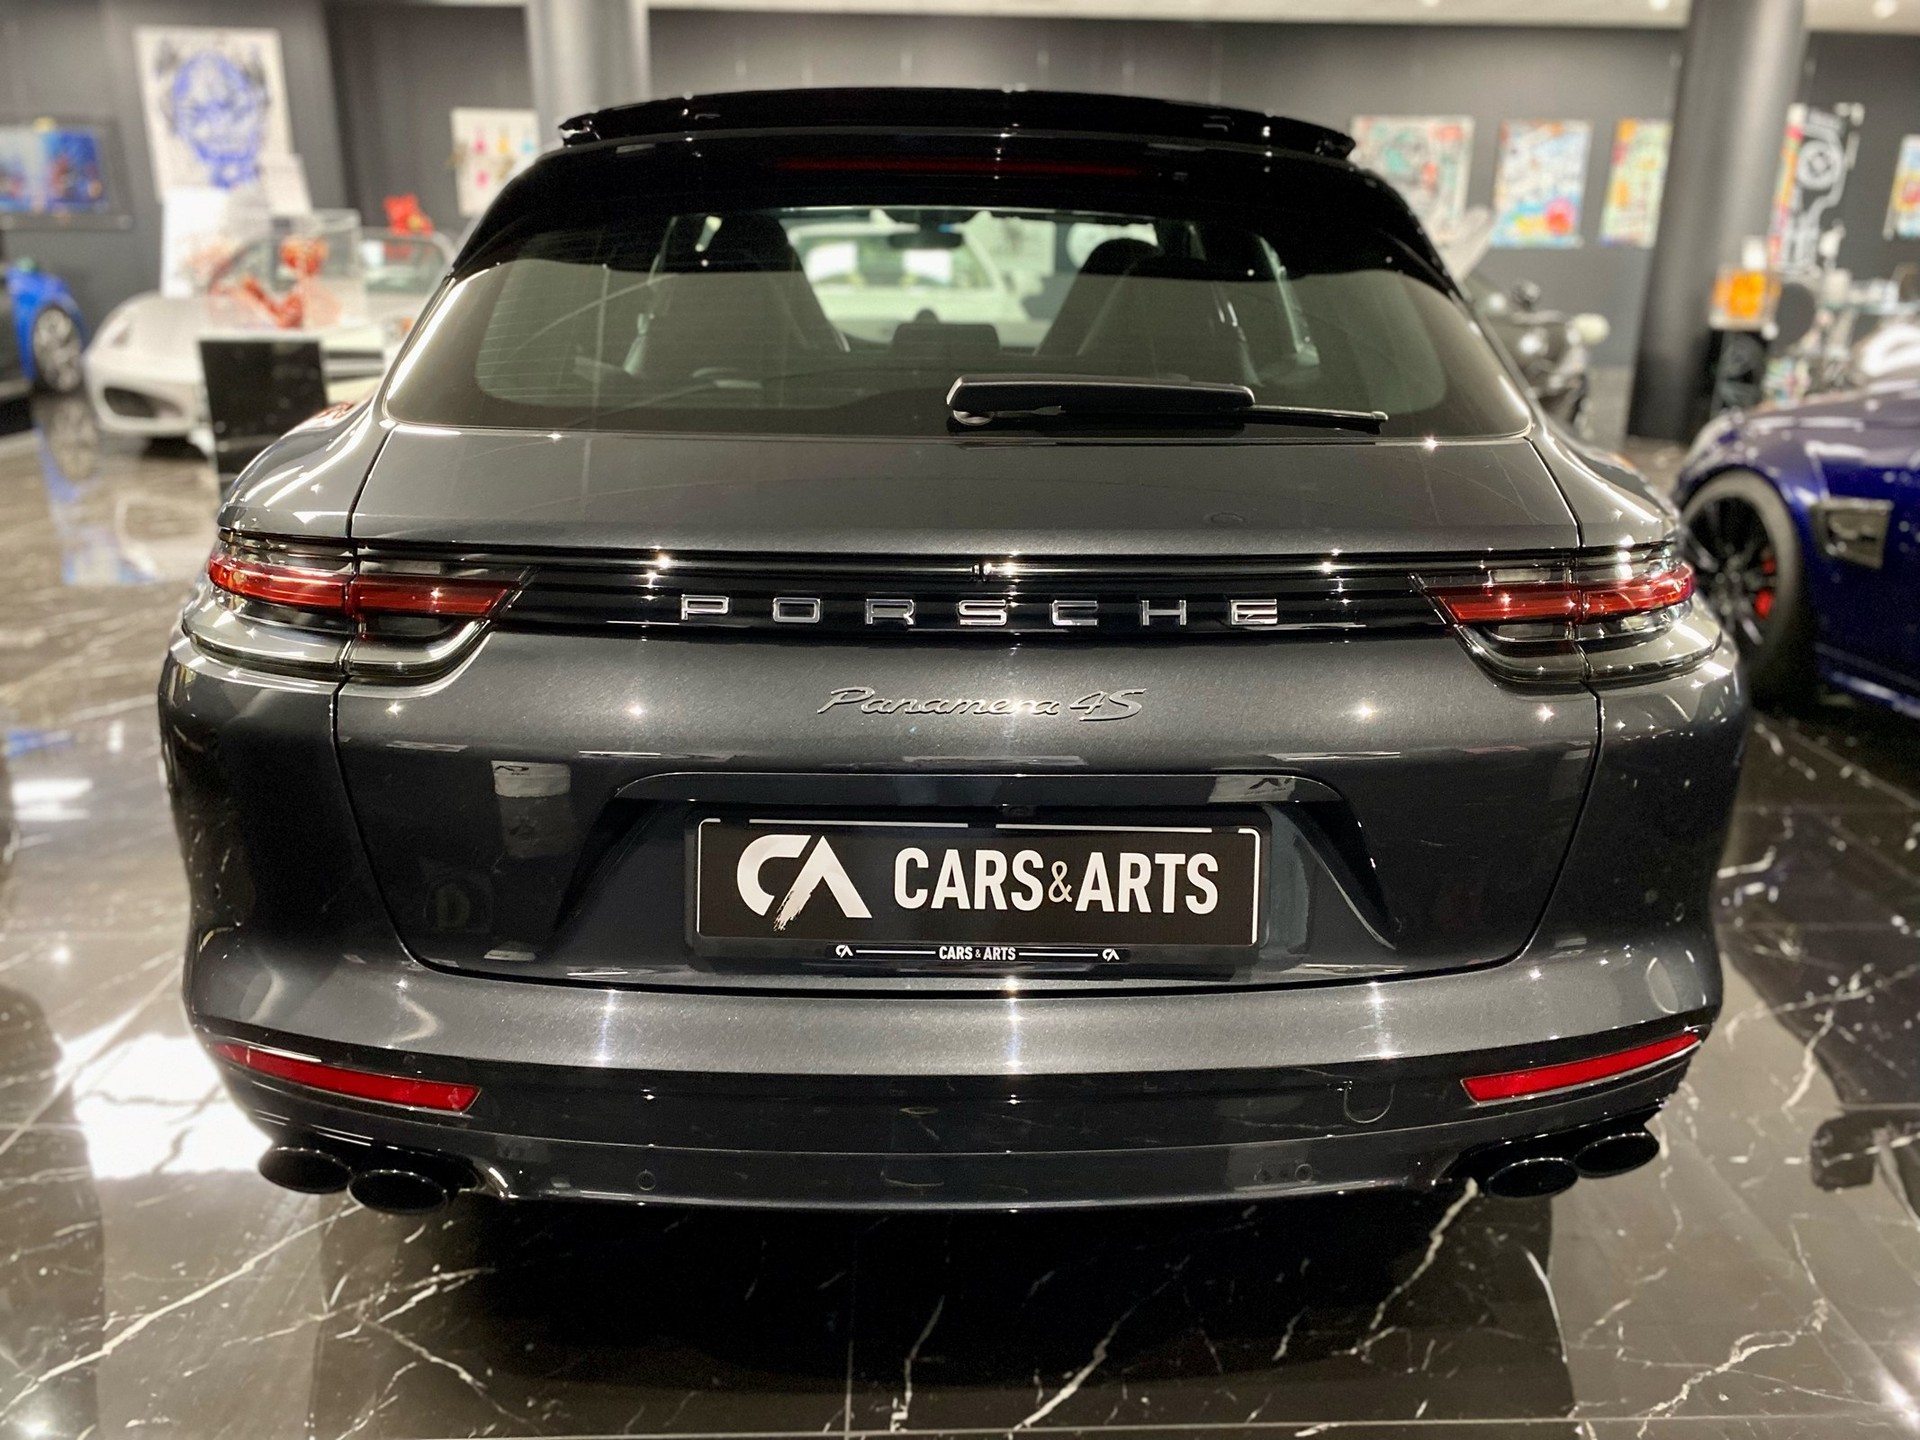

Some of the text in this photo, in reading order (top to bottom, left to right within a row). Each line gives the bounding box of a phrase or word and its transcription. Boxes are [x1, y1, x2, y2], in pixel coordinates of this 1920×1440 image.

[681, 594, 1278, 626] PORSCHE
[817, 686, 1147, 722] Panamera 4S
[939, 946, 973, 960] CARS
[975, 949, 982, 958] &
[983, 947, 1016, 961] ARTS
